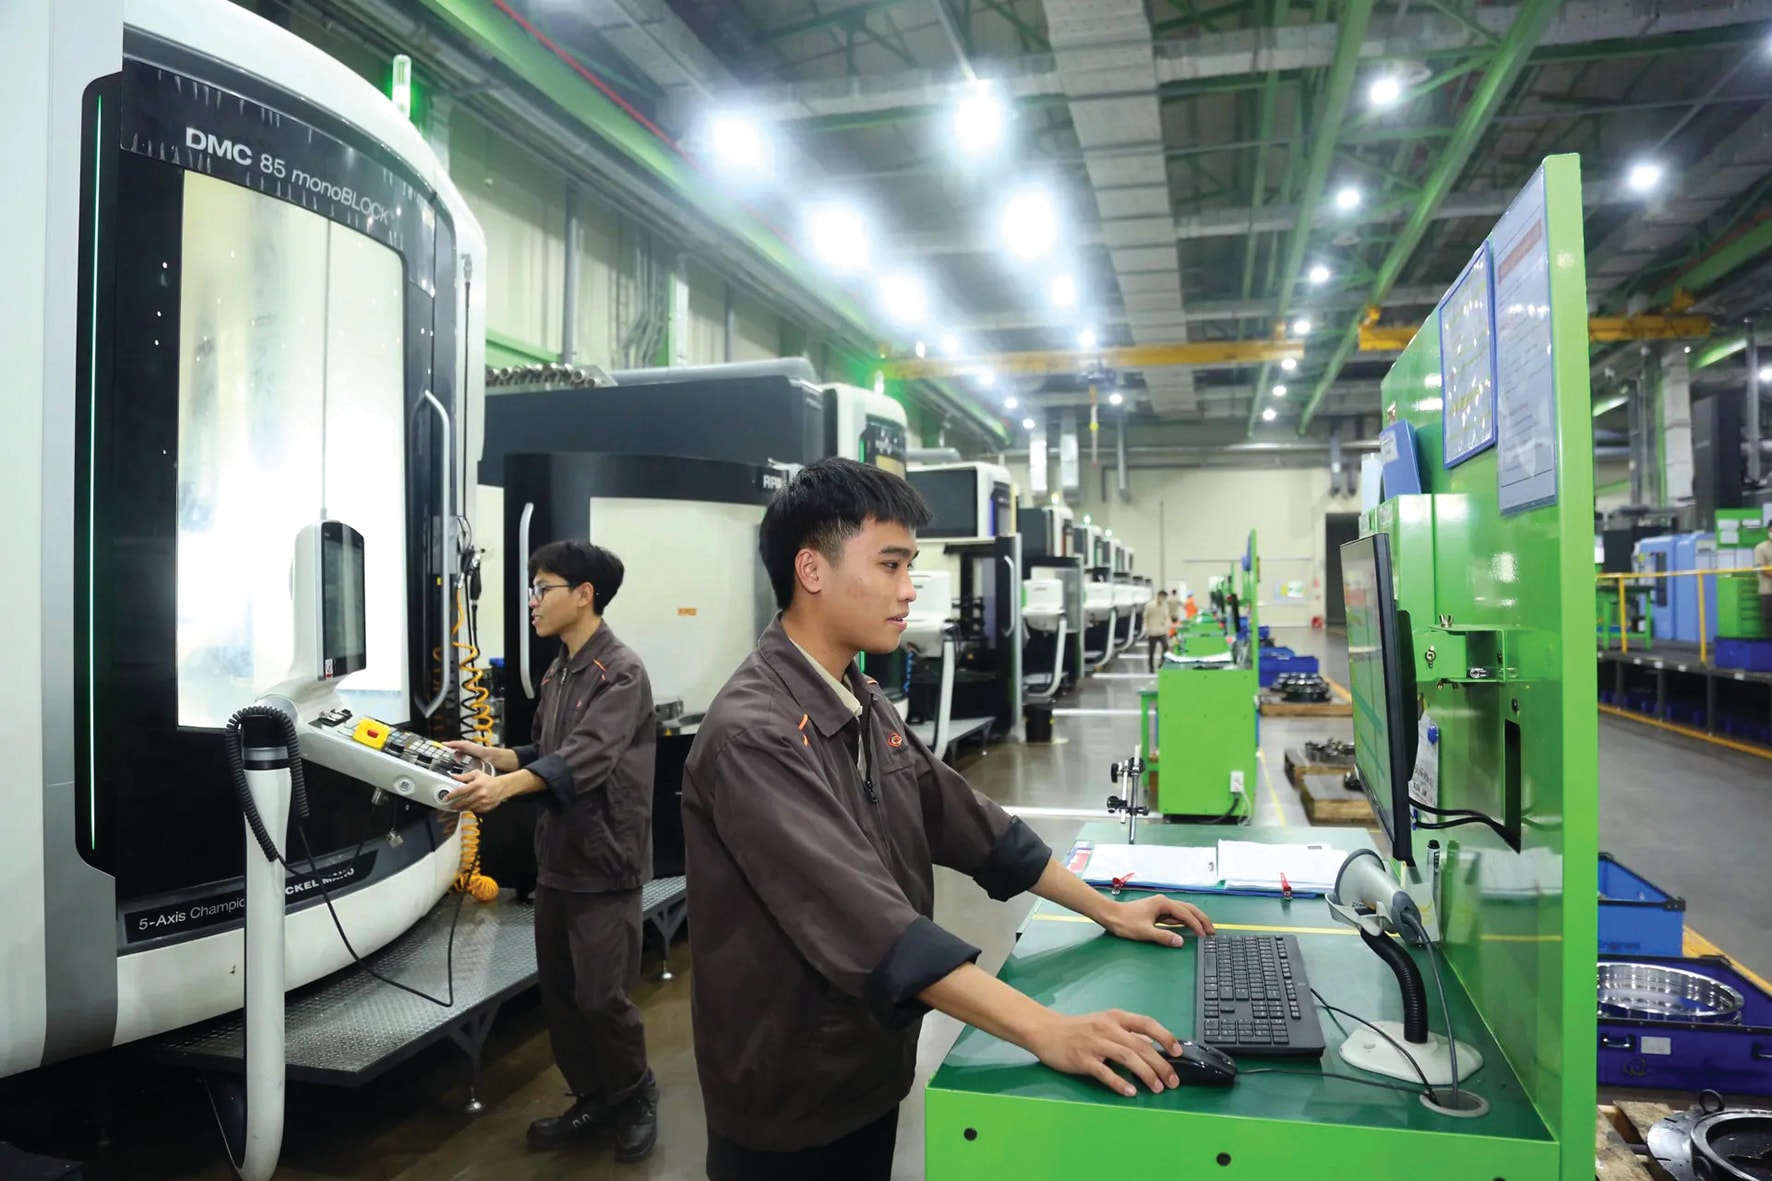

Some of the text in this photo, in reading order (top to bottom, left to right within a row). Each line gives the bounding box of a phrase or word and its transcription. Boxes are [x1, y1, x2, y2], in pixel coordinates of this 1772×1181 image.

[185, 126, 389, 225] DMC 85 monoBLOCK
[138, 911, 186, 931] 5-Axis
[190, 897, 245, 919] Champio
[285, 879, 320, 895] CKEL
